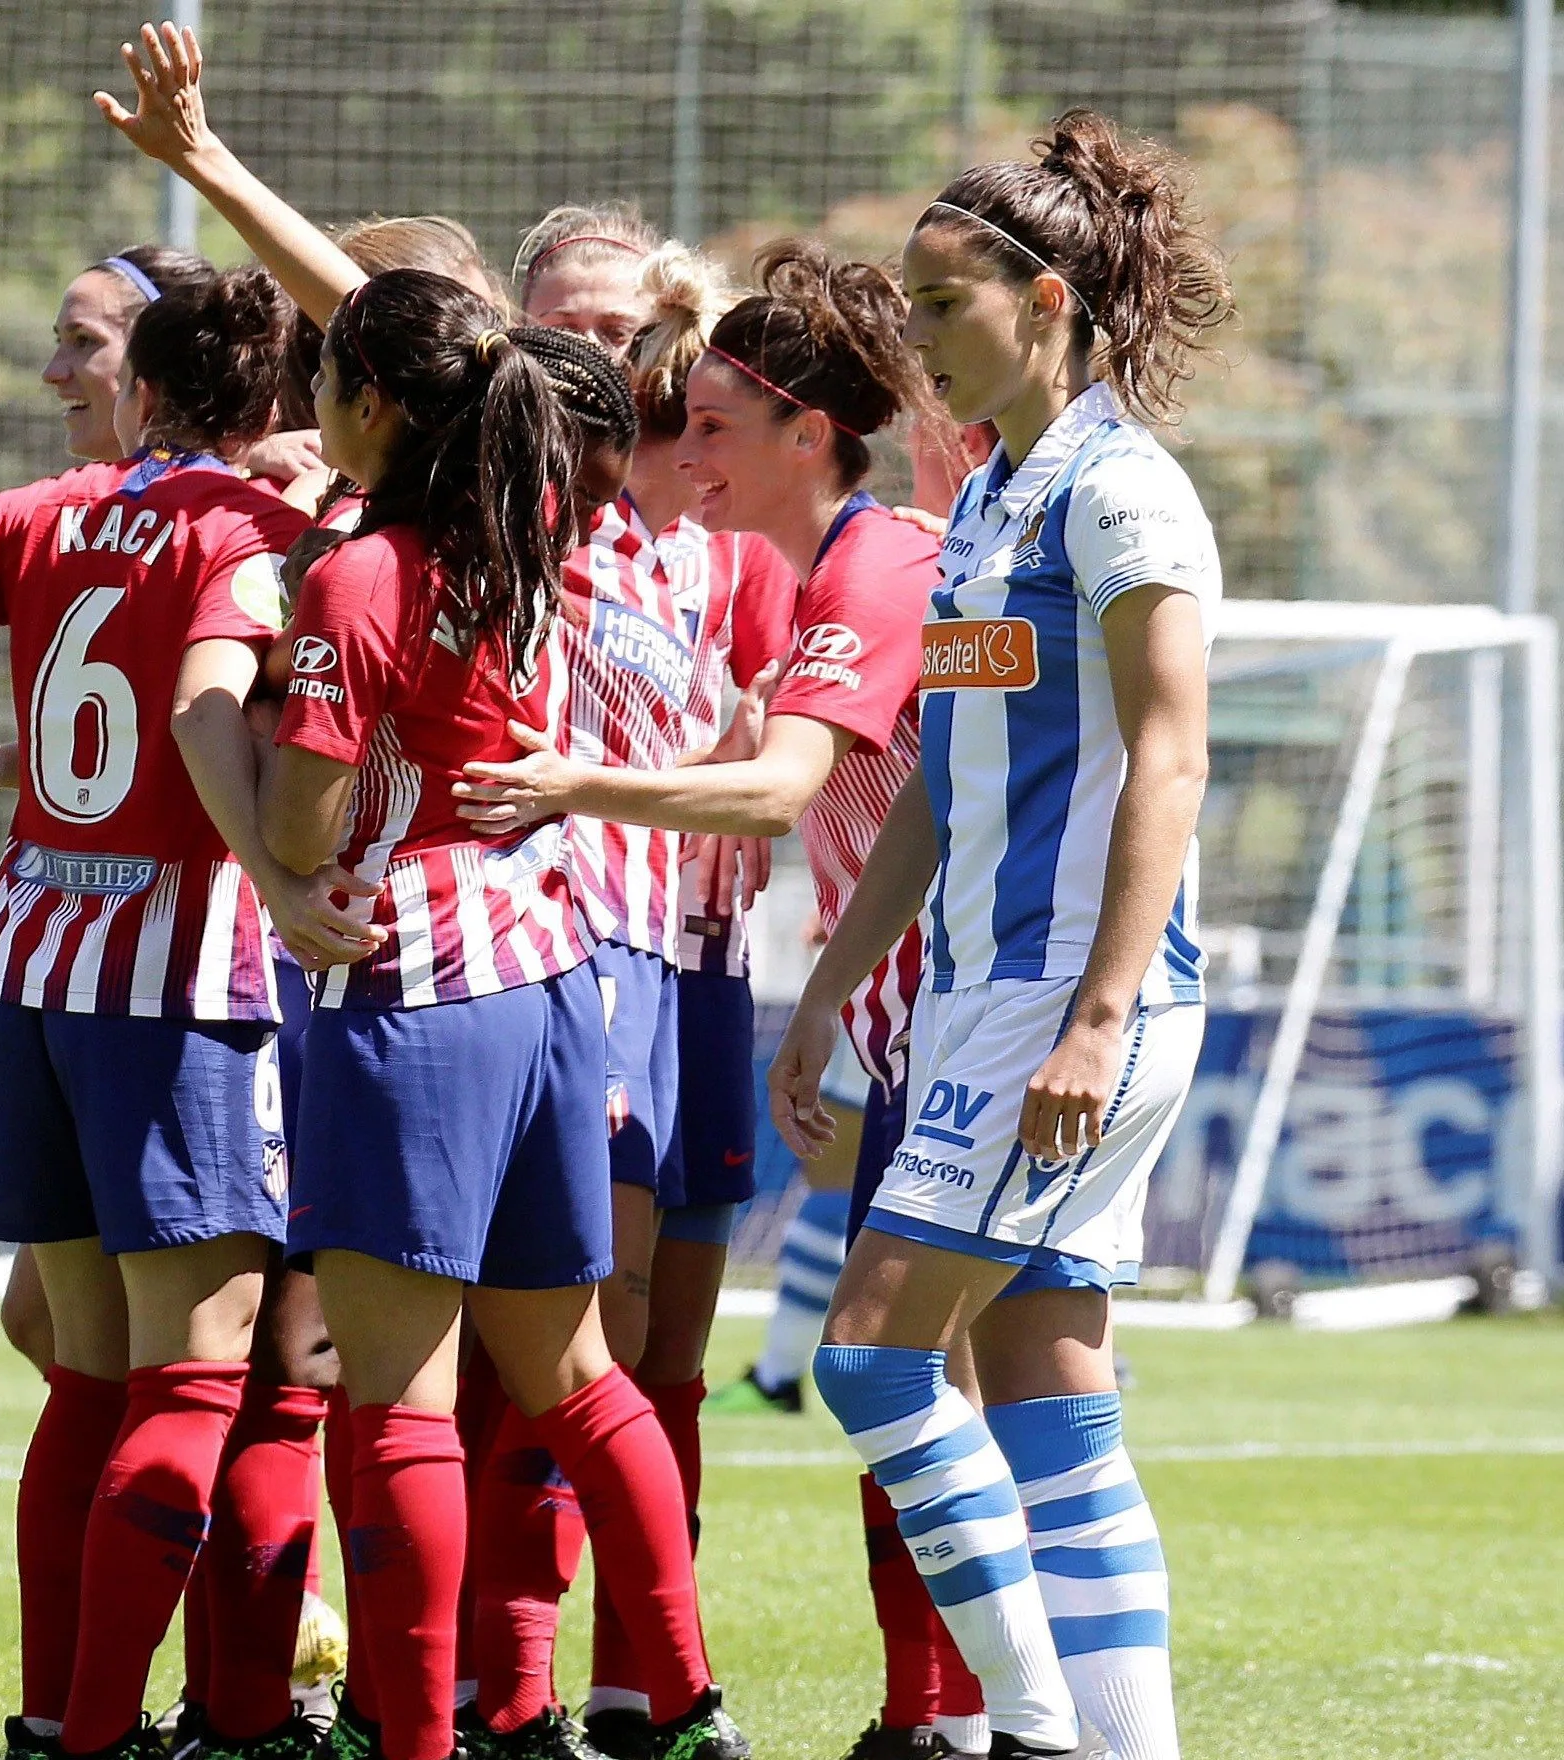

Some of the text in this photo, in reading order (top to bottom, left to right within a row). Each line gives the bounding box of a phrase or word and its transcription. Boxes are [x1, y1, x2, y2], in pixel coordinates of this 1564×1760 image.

[58, 503, 175, 567] KACI
[920, 634, 980, 676] skaltel
[29, 585, 139, 825] 6
[253, 1030, 284, 1134] 6
[918, 1078, 995, 1131] DV
[914, 1540, 956, 1561] RS
